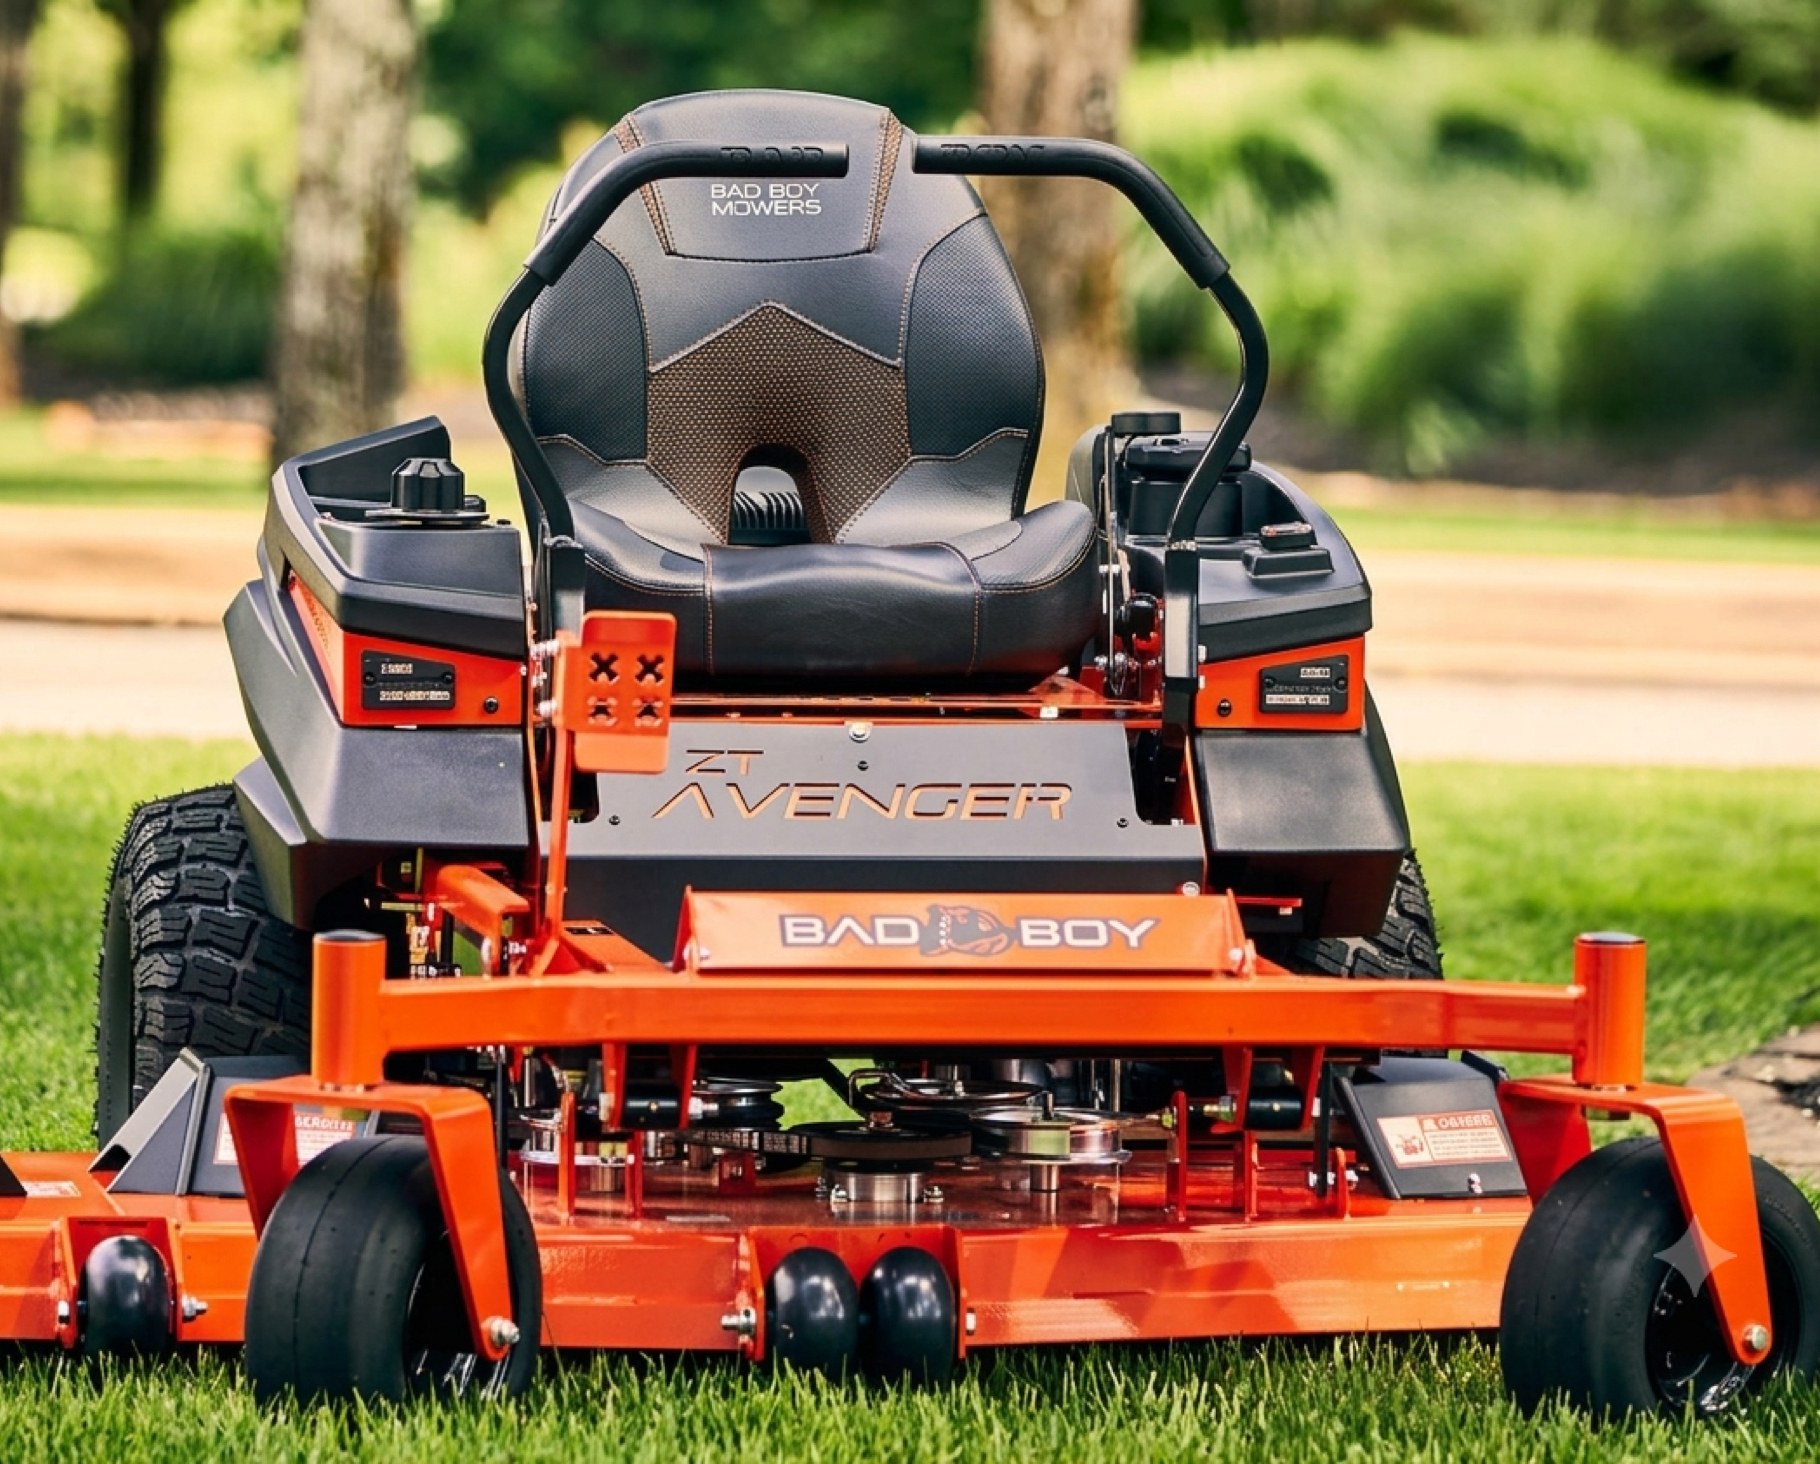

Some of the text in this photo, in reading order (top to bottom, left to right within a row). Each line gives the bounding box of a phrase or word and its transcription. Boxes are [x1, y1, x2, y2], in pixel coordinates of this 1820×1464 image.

[711, 183, 820, 199] BAD BOY
[711, 200, 822, 216] MOWERS
[685, 749, 764, 775] ZT
[651, 782, 1072, 821] AVENGER
[780, 914, 1160, 949] BAD BOY
